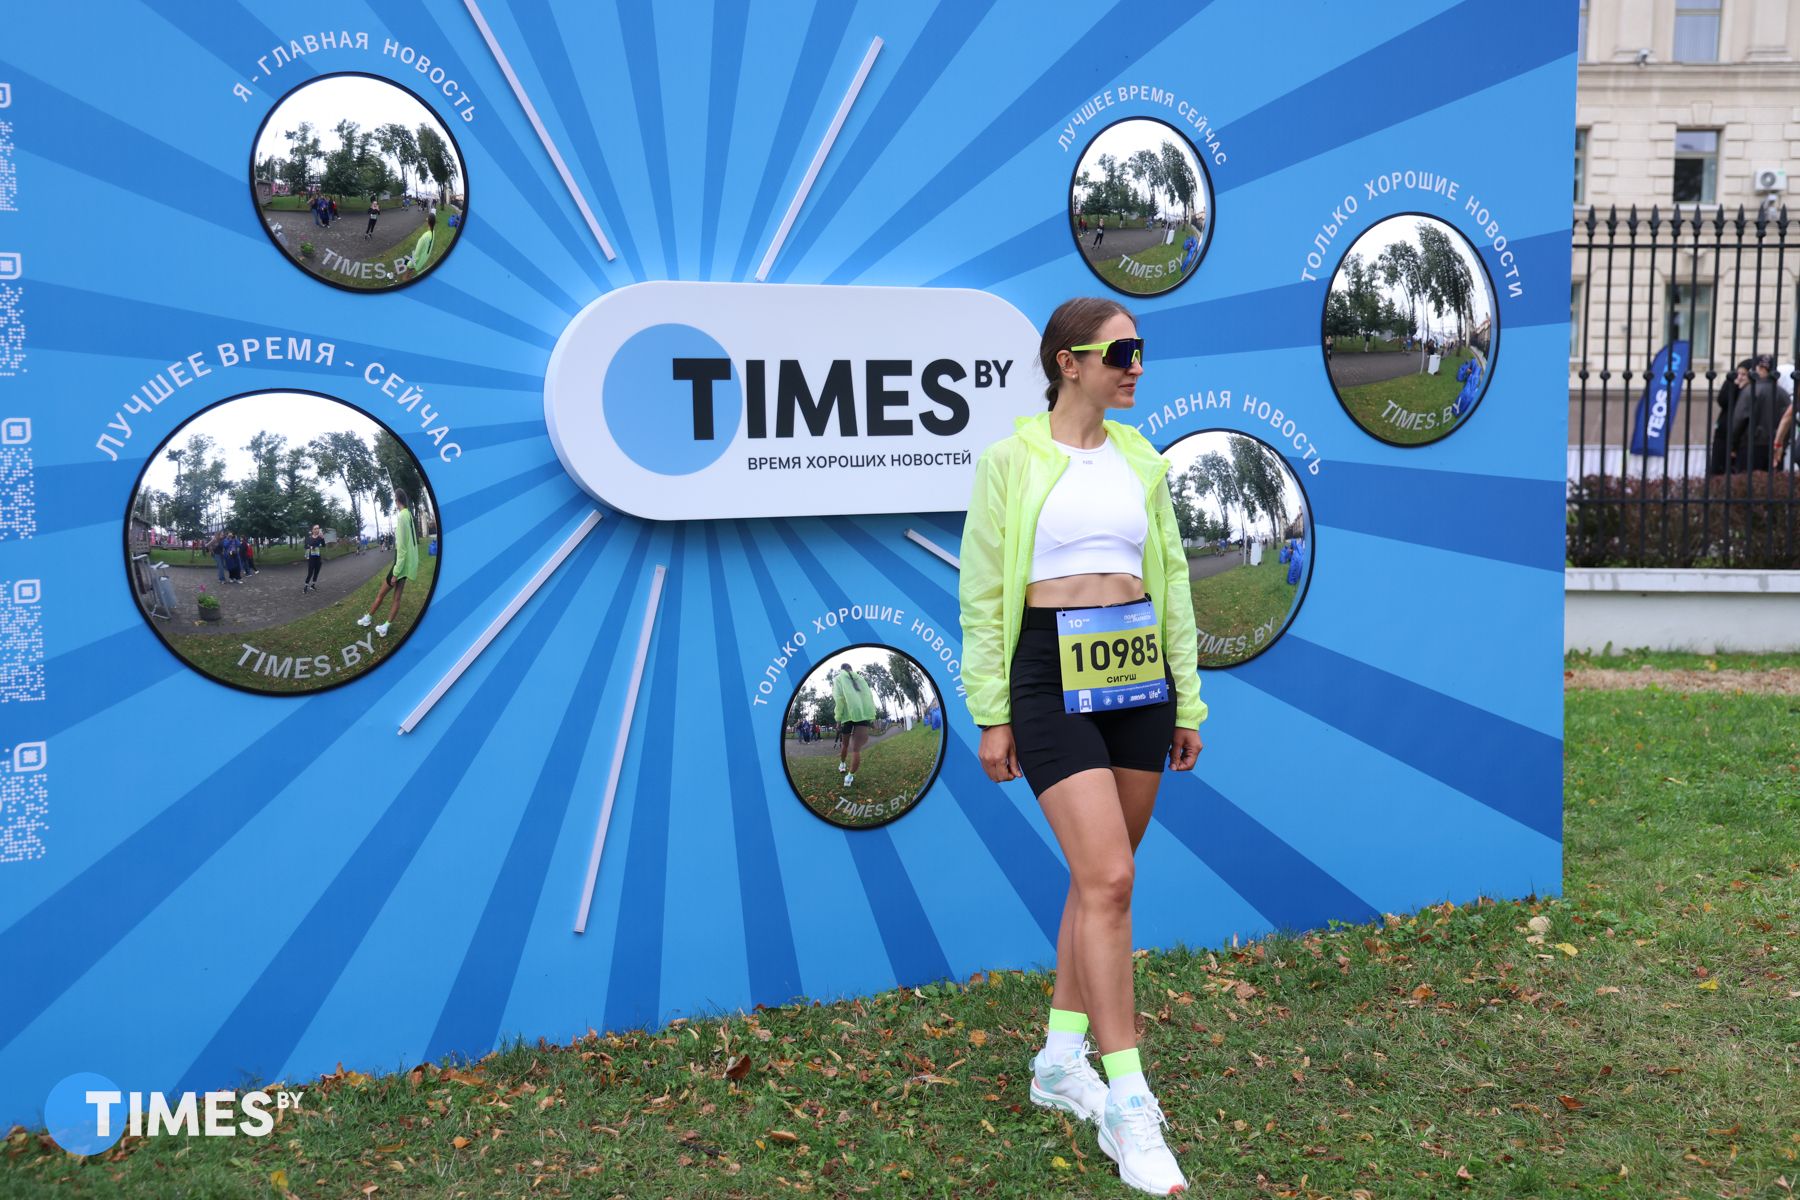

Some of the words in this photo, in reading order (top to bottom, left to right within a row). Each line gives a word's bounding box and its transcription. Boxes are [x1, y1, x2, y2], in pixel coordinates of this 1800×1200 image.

[383, 38, 476, 123] НОВОСТЬ
[1058, 90, 1115, 152] ЛУЧШЕЕ
[1117, 85, 1175, 108] ВРЕМЯ
[1177, 100, 1228, 166] СЕЙЧАС
[1118, 252, 1184, 279] TIMES.BY
[1301, 195, 1359, 282] ТОЛЬКО
[1364, 170, 1460, 201] ХОРОШИЕ
[1464, 195, 1523, 298] НОВОСТИ
[96, 351, 212, 462] ЛУЧШЕЕ
[217, 336, 337, 367] ВРЕМЯ
[364, 362, 463, 464] СЕЙЧАС
[672, 358, 971, 441] TIMES
[974, 360, 1013, 387] BY
[1242, 394, 1322, 476] НОВОСТЬ
[1381, 397, 1462, 431] TIMES.BY
[747, 456, 801, 471] ВРЕМЯ
[806, 454, 887, 469] ХОРОШИХ
[891, 449, 972, 466] НОВОСТЕЙ
[235, 632, 375, 680] TIMES.BY
[753, 631, 807, 707] ТОЛЬКО
[812, 604, 905, 634] ХОРОШИЕ
[1071, 633, 1158, 673] 10985
[1106, 674, 1137, 684] СИГУШ
